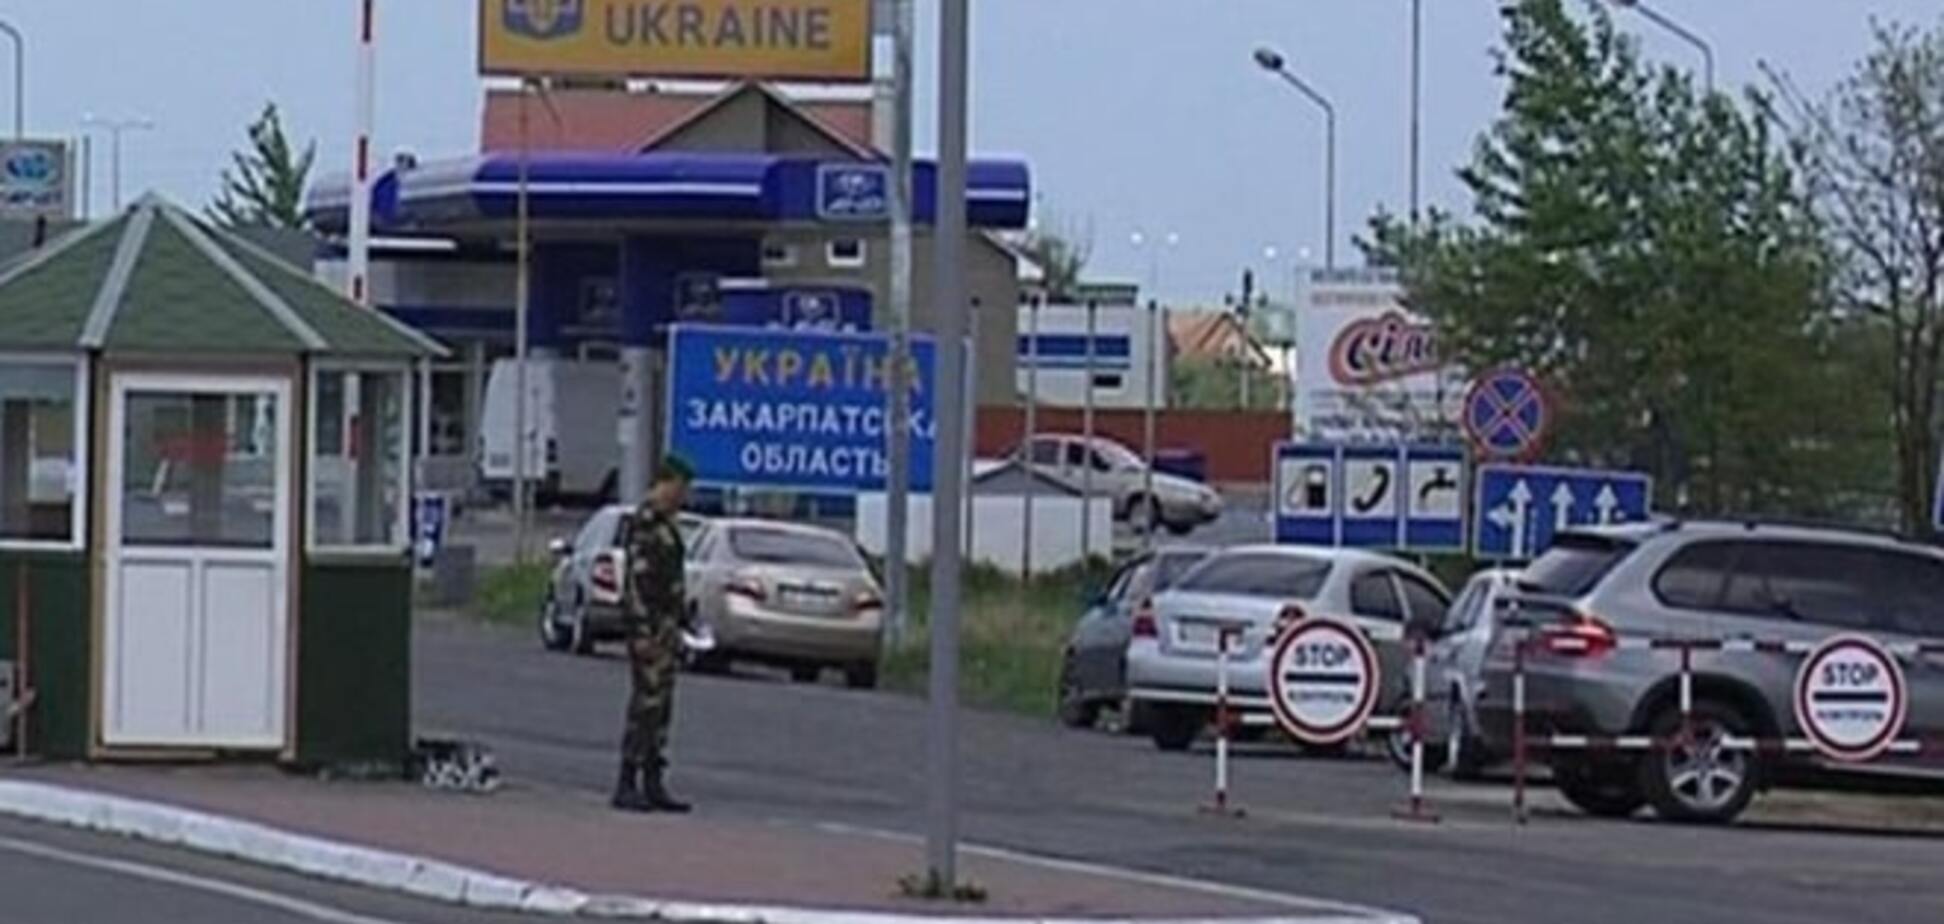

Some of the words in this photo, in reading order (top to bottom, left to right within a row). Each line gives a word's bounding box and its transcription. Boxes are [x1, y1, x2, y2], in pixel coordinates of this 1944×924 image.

[605, 6, 832, 50] UKRAINE
[713, 345, 924, 393] УКРАЇНА
[686, 399, 937, 438] ЗАКАРПАТСК
[1295, 643, 1352, 668] STOP
[1823, 661, 1880, 687] STOP
